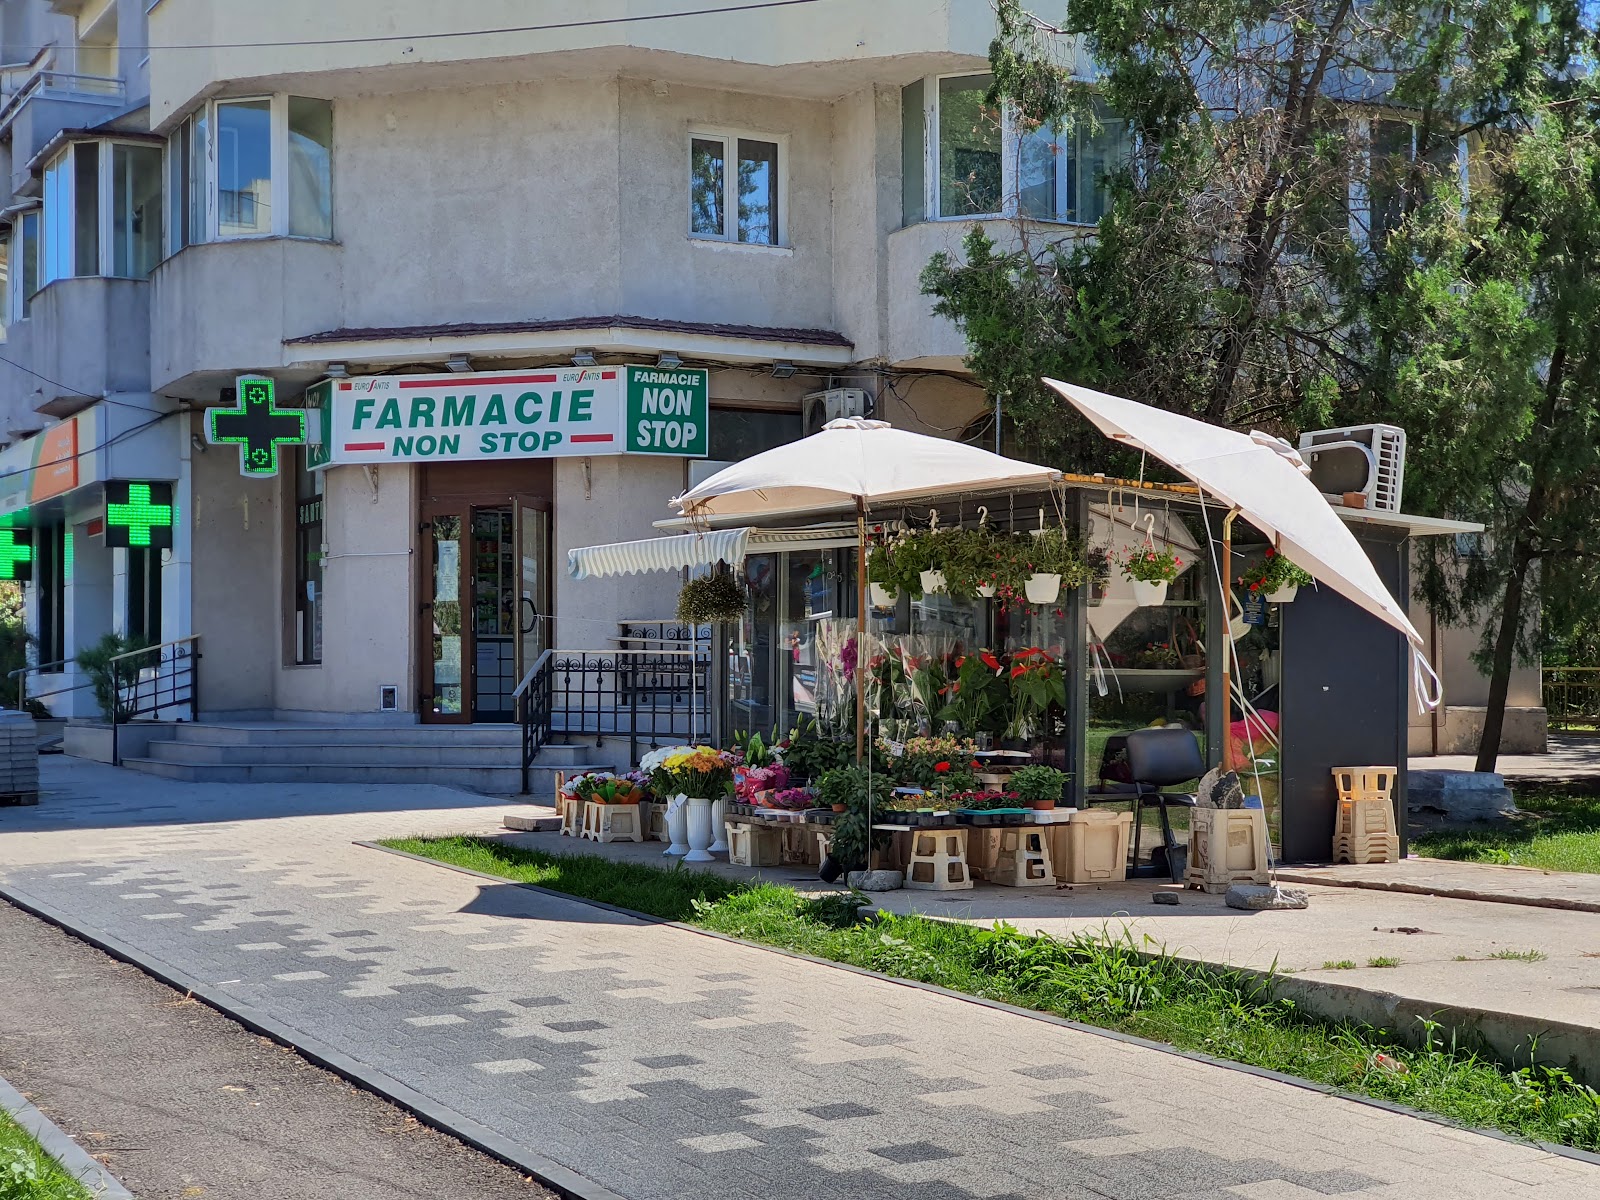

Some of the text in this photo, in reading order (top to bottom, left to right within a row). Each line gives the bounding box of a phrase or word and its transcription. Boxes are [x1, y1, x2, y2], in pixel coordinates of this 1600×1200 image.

[634, 371, 700, 386] FARMACIE
[352, 389, 595, 430] FARMACIE
[641, 387, 693, 416] NON
[392, 430, 563, 457] NON STOP
[636, 419, 697, 448] STOP
